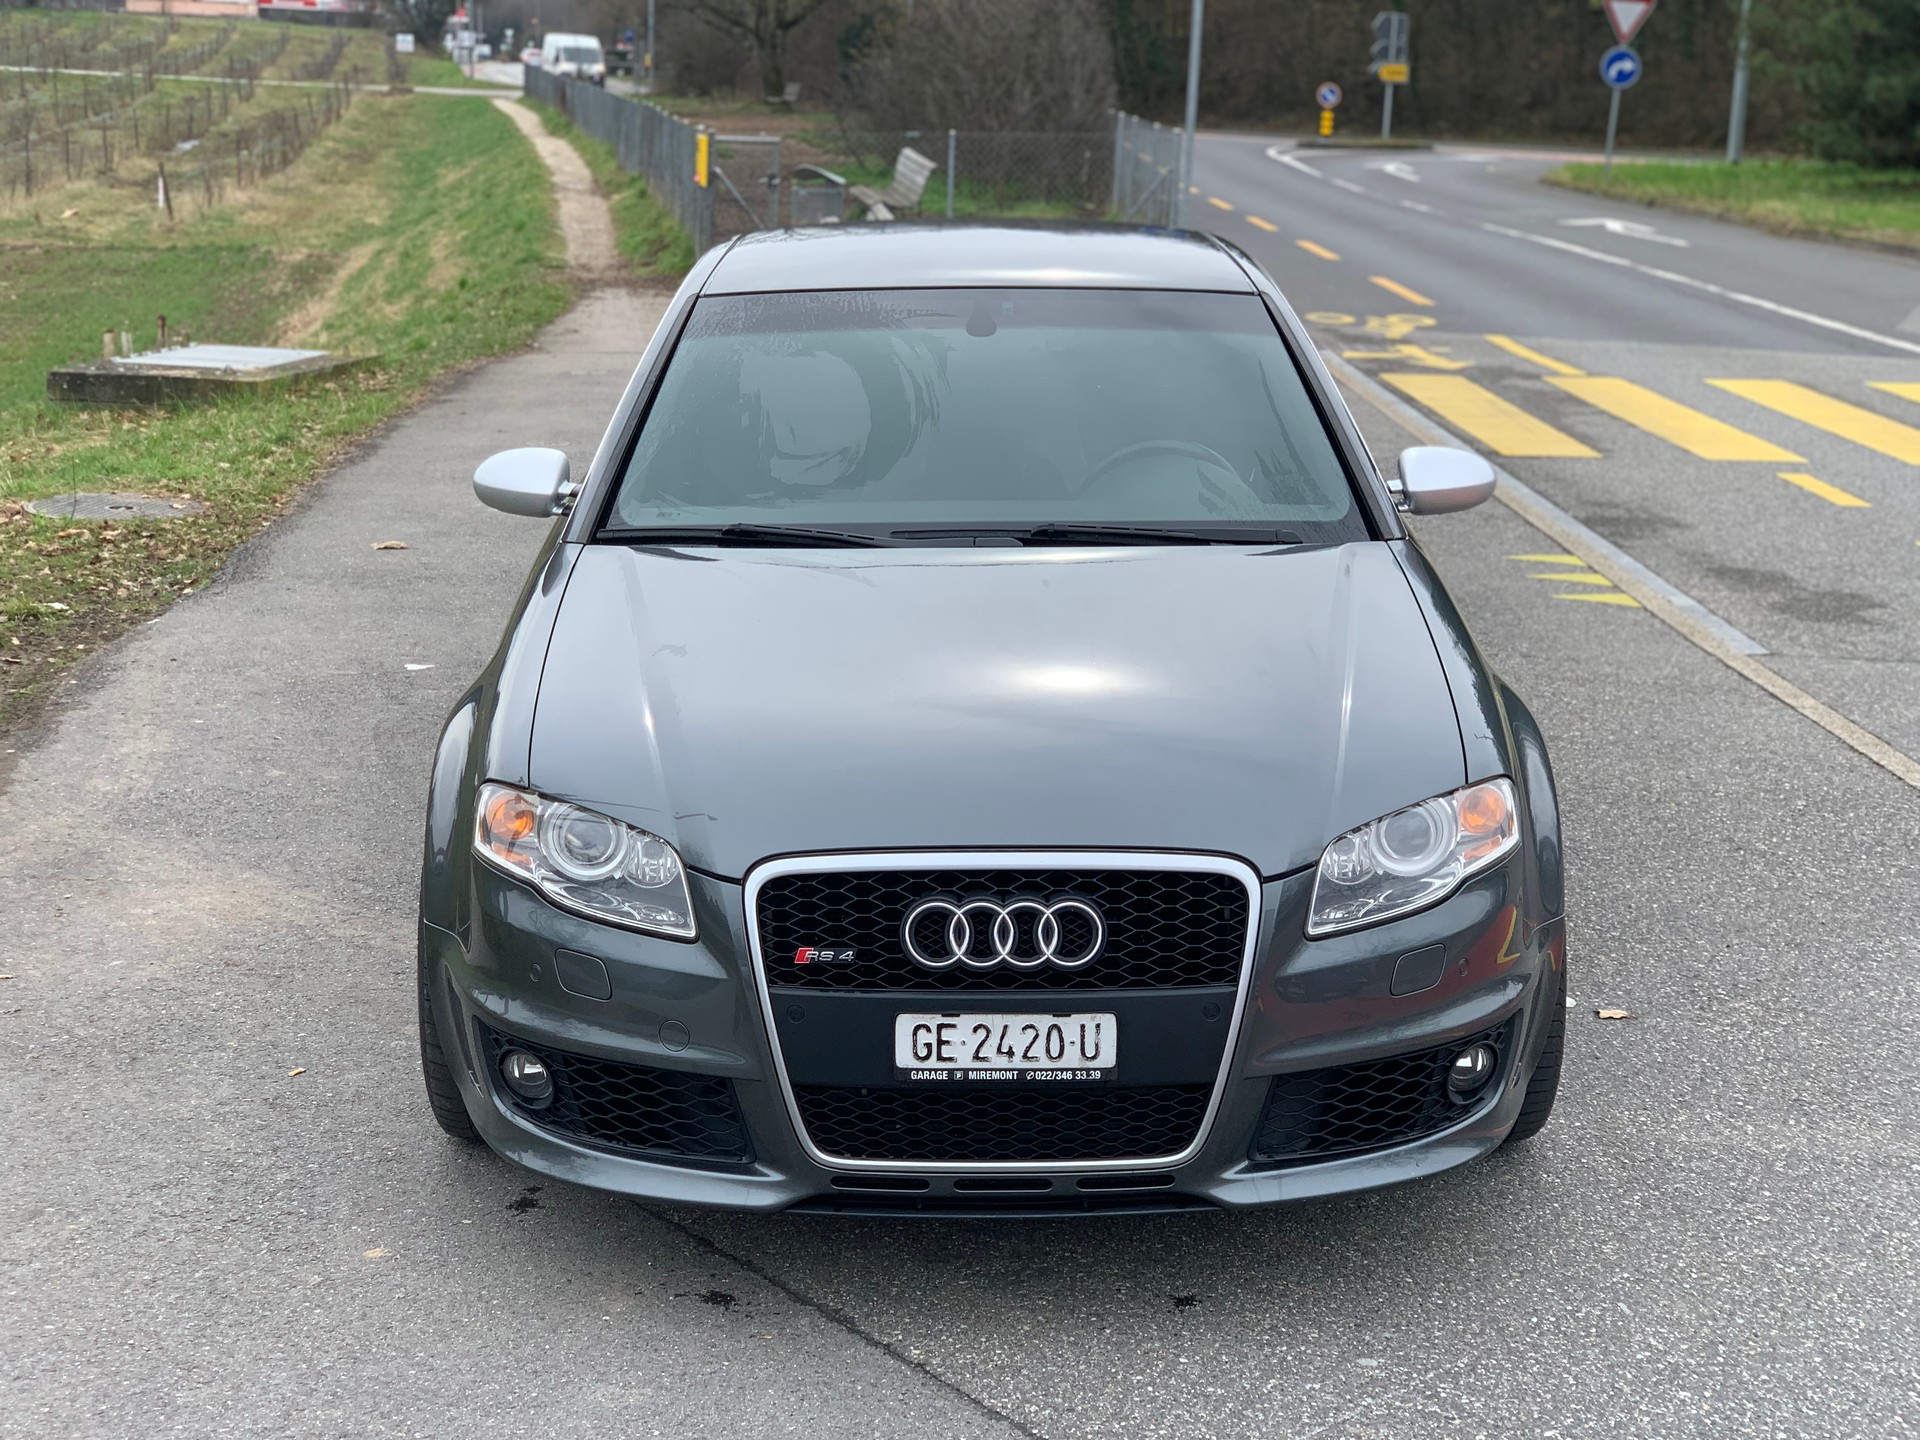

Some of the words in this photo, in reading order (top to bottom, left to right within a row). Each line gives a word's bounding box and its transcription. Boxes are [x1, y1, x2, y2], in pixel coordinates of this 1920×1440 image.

[804, 951, 835, 961] RS
[838, 951, 855, 962] 4
[910, 1070, 949, 1080] GARAGE
[968, 1070, 1019, 1080] MIREMONT
[1035, 1070, 1073, 1080] 022/346
